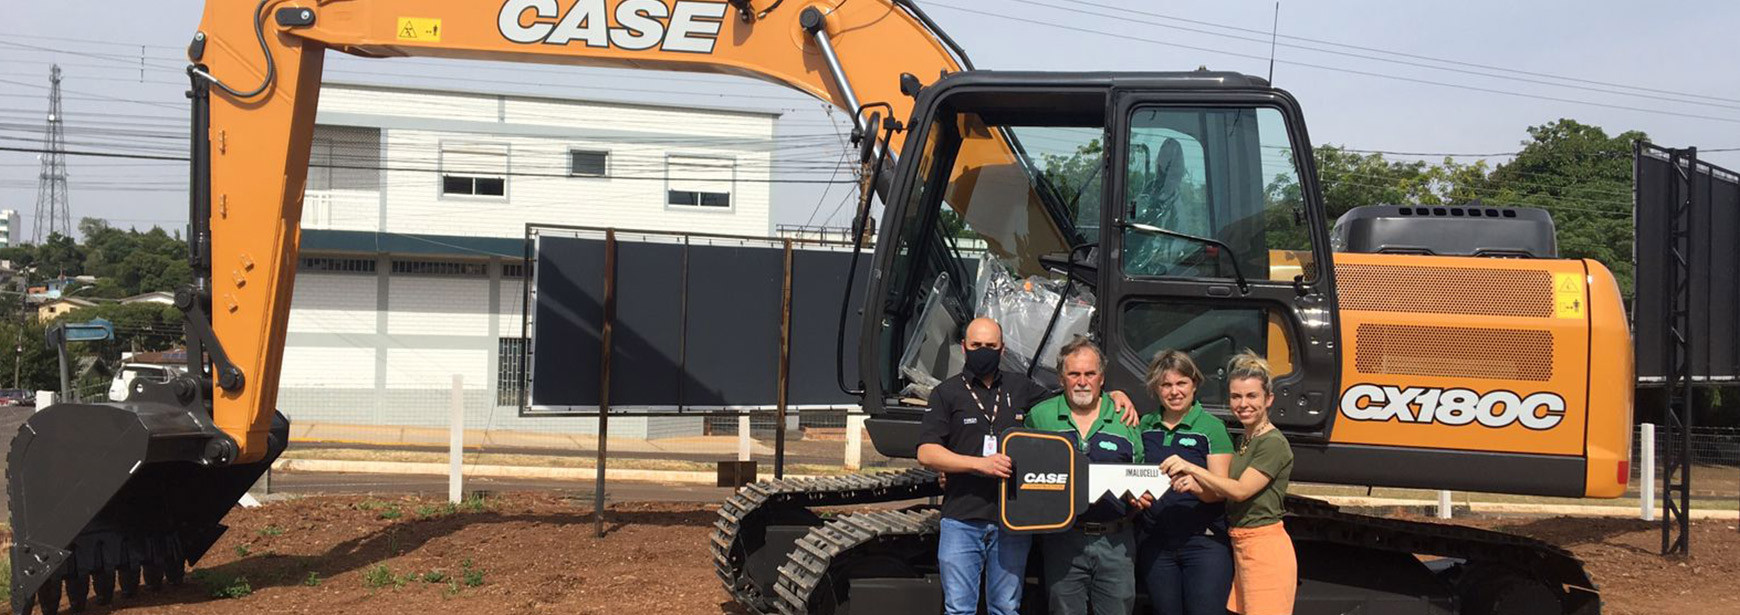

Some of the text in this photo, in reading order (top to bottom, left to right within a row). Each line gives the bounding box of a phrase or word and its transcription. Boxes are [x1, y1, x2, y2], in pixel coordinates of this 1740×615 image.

[498, 0, 728, 54] CASE
[1340, 383, 1566, 430] CX180C
[1024, 472, 1068, 484] CASE
